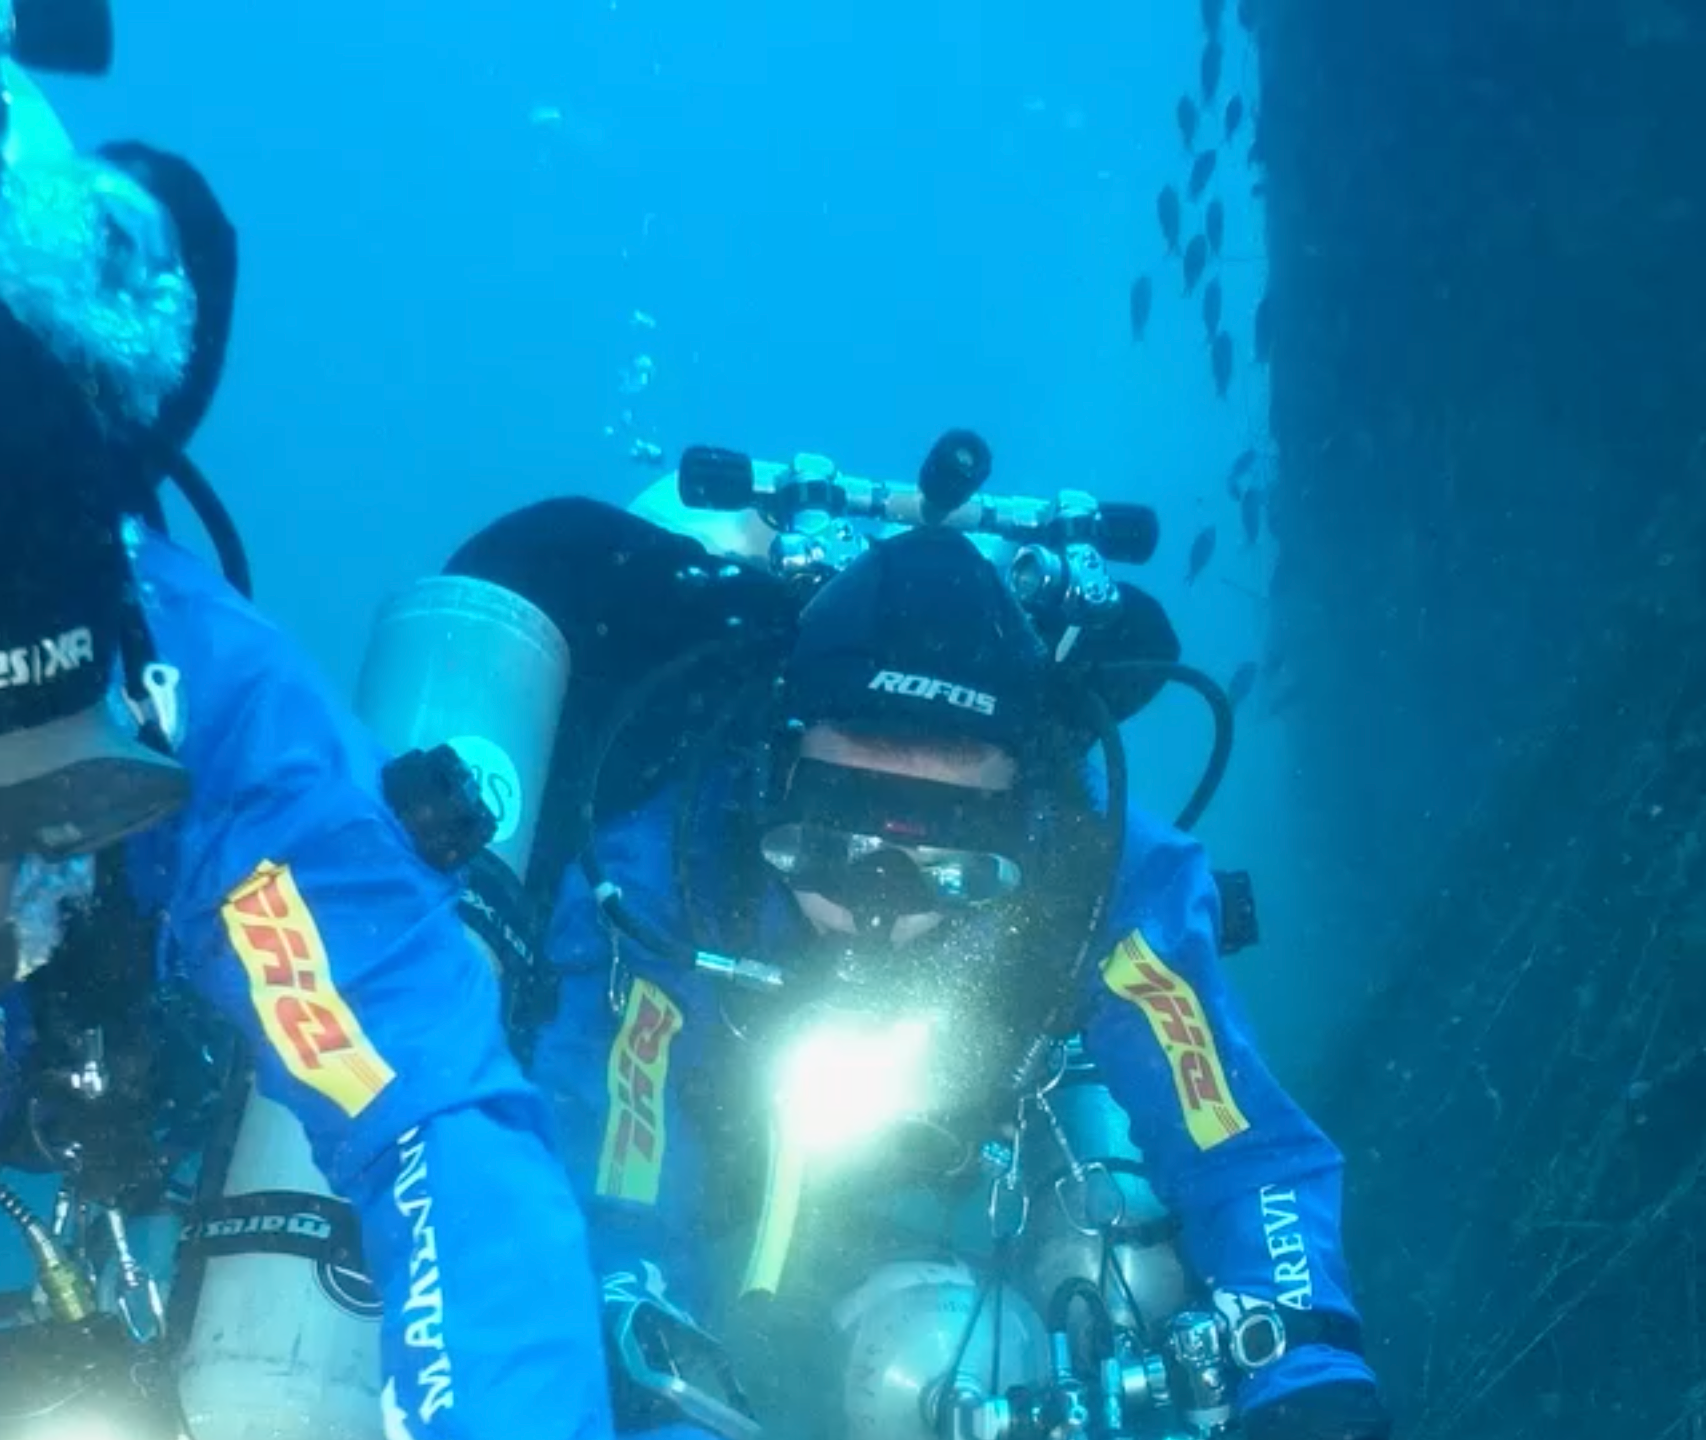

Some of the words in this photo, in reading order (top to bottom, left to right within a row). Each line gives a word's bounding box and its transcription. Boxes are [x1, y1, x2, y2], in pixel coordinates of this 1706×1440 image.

[867, 670, 997, 716] ROFOS
[612, 992, 675, 1167] DHL
[1123, 962, 1225, 1111] DHL
